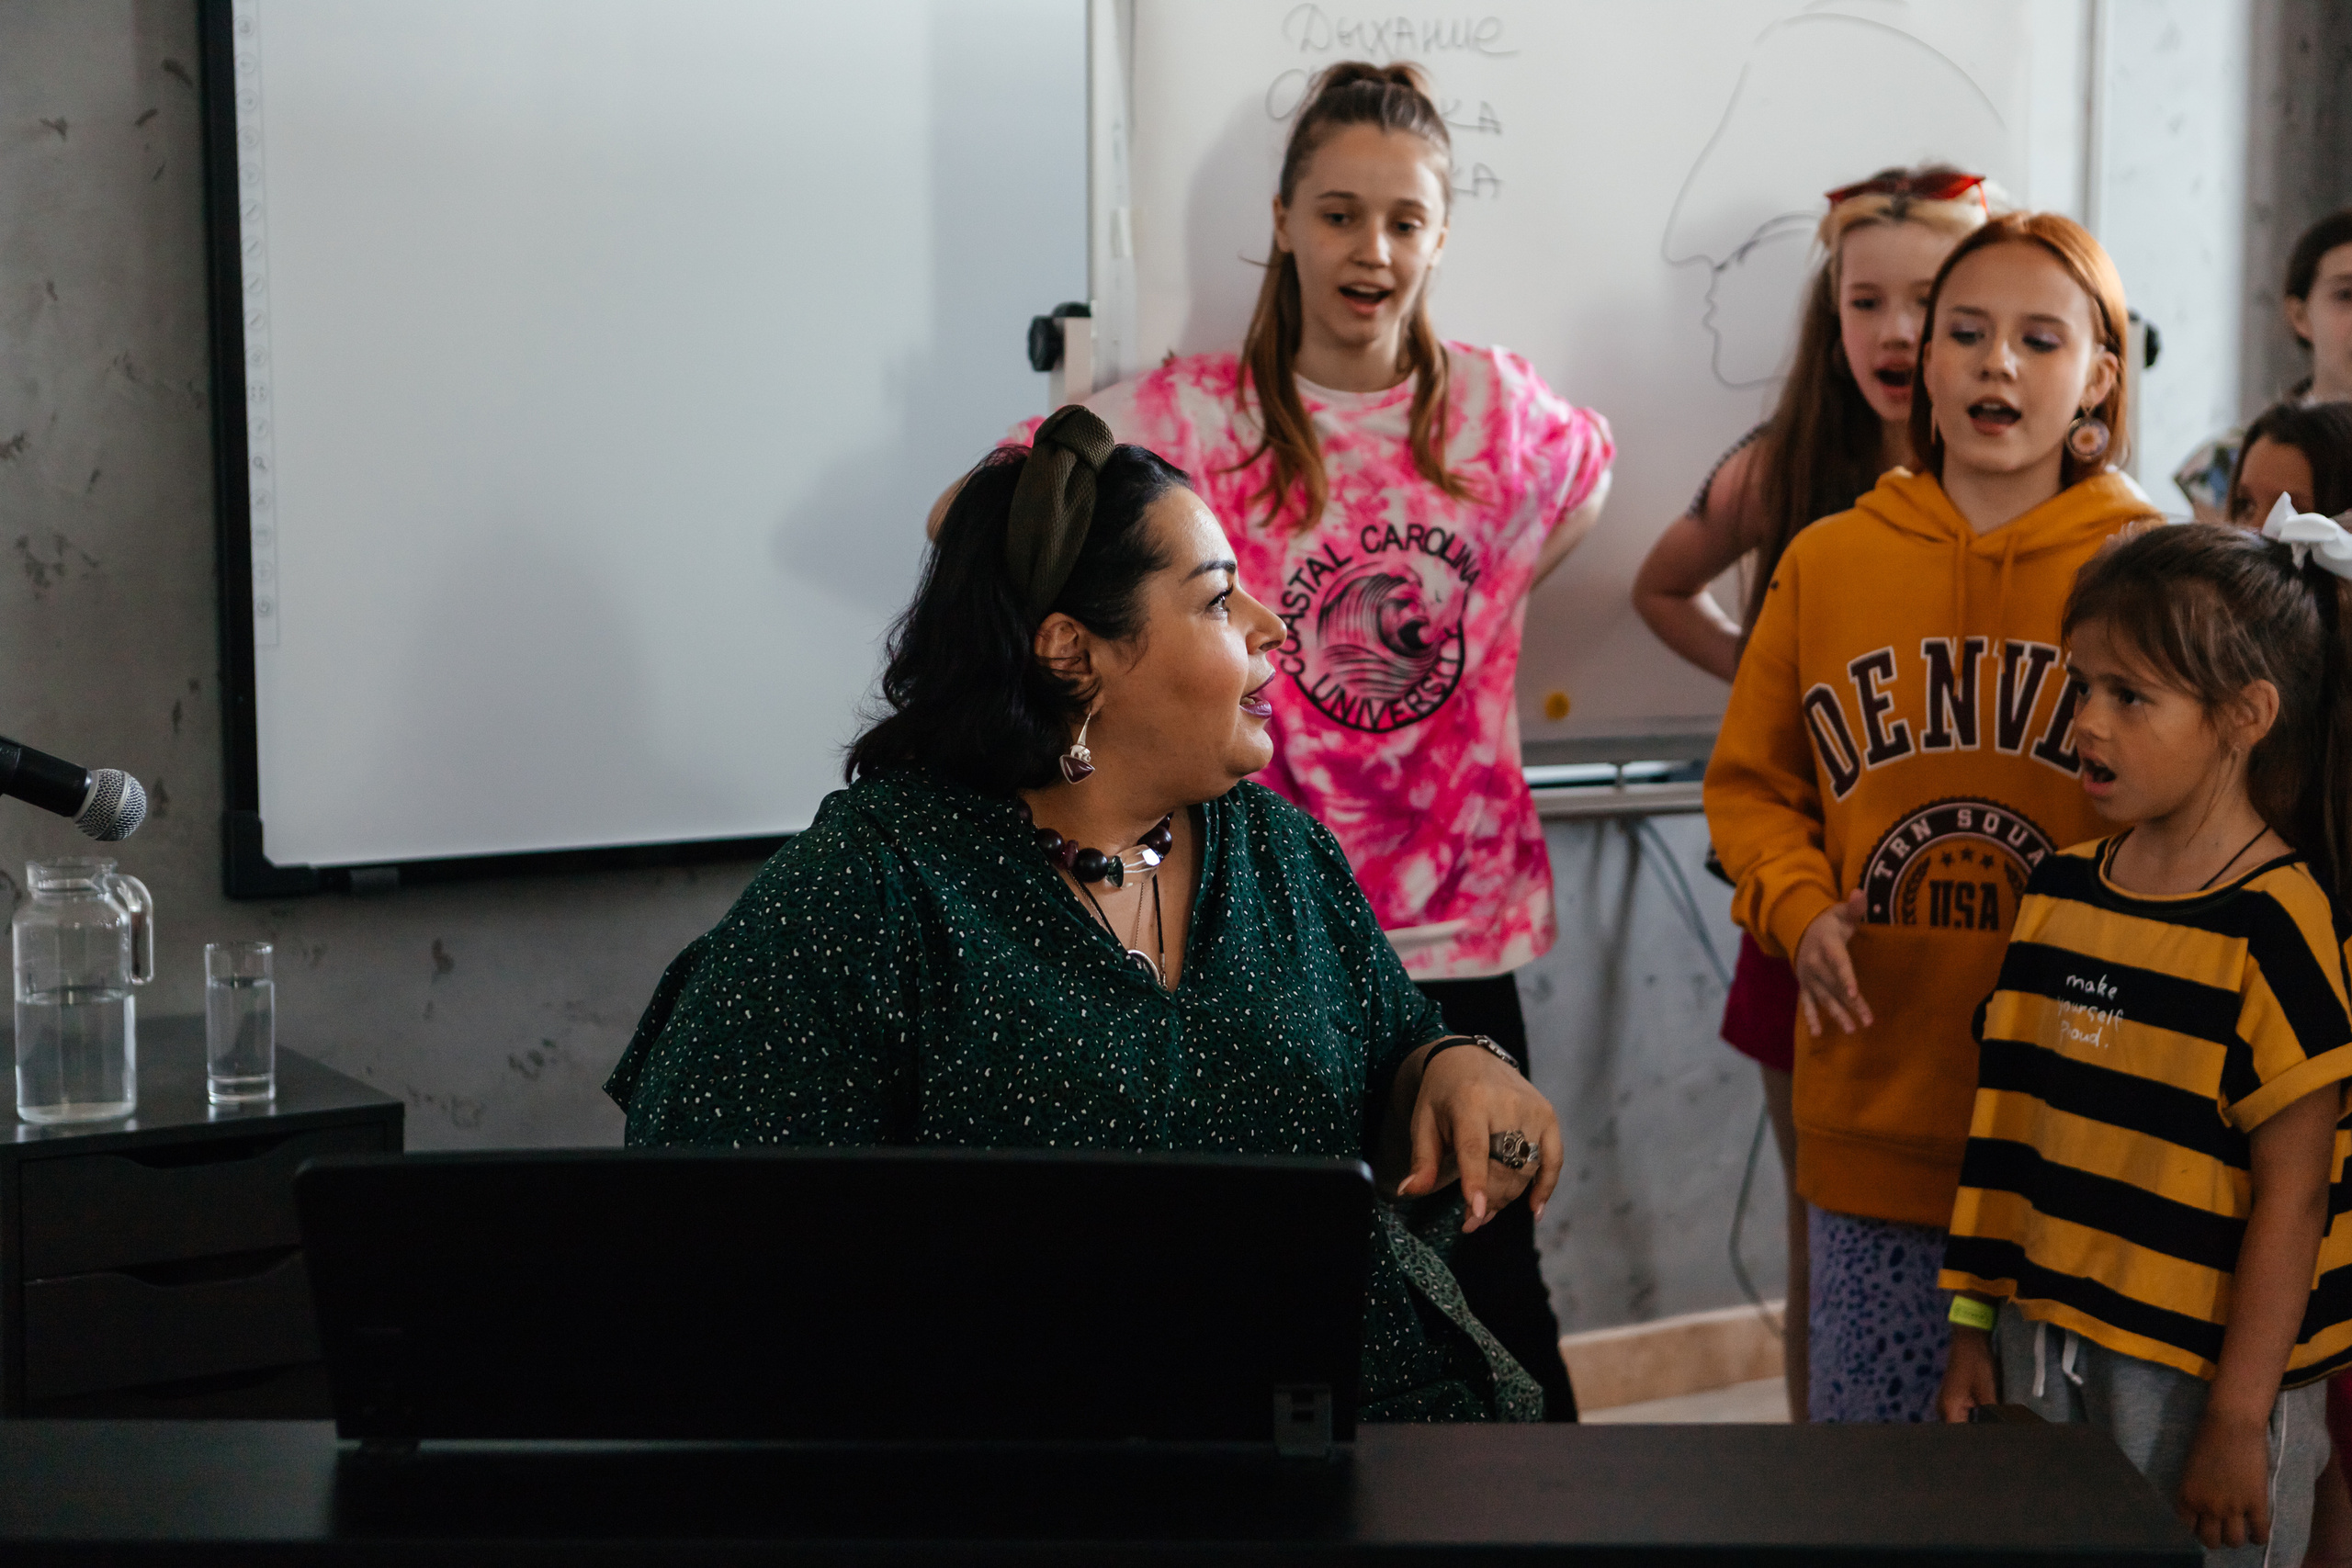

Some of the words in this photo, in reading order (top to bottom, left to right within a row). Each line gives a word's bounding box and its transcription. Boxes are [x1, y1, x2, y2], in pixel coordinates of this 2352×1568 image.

[1278, 543, 1352, 676] COASTAL
[1311, 626, 1461, 732] UNIVERSITY
[1875, 818, 1932, 879] TRN
[1928, 879, 2000, 931] USA
[2066, 974, 2118, 1000] make
